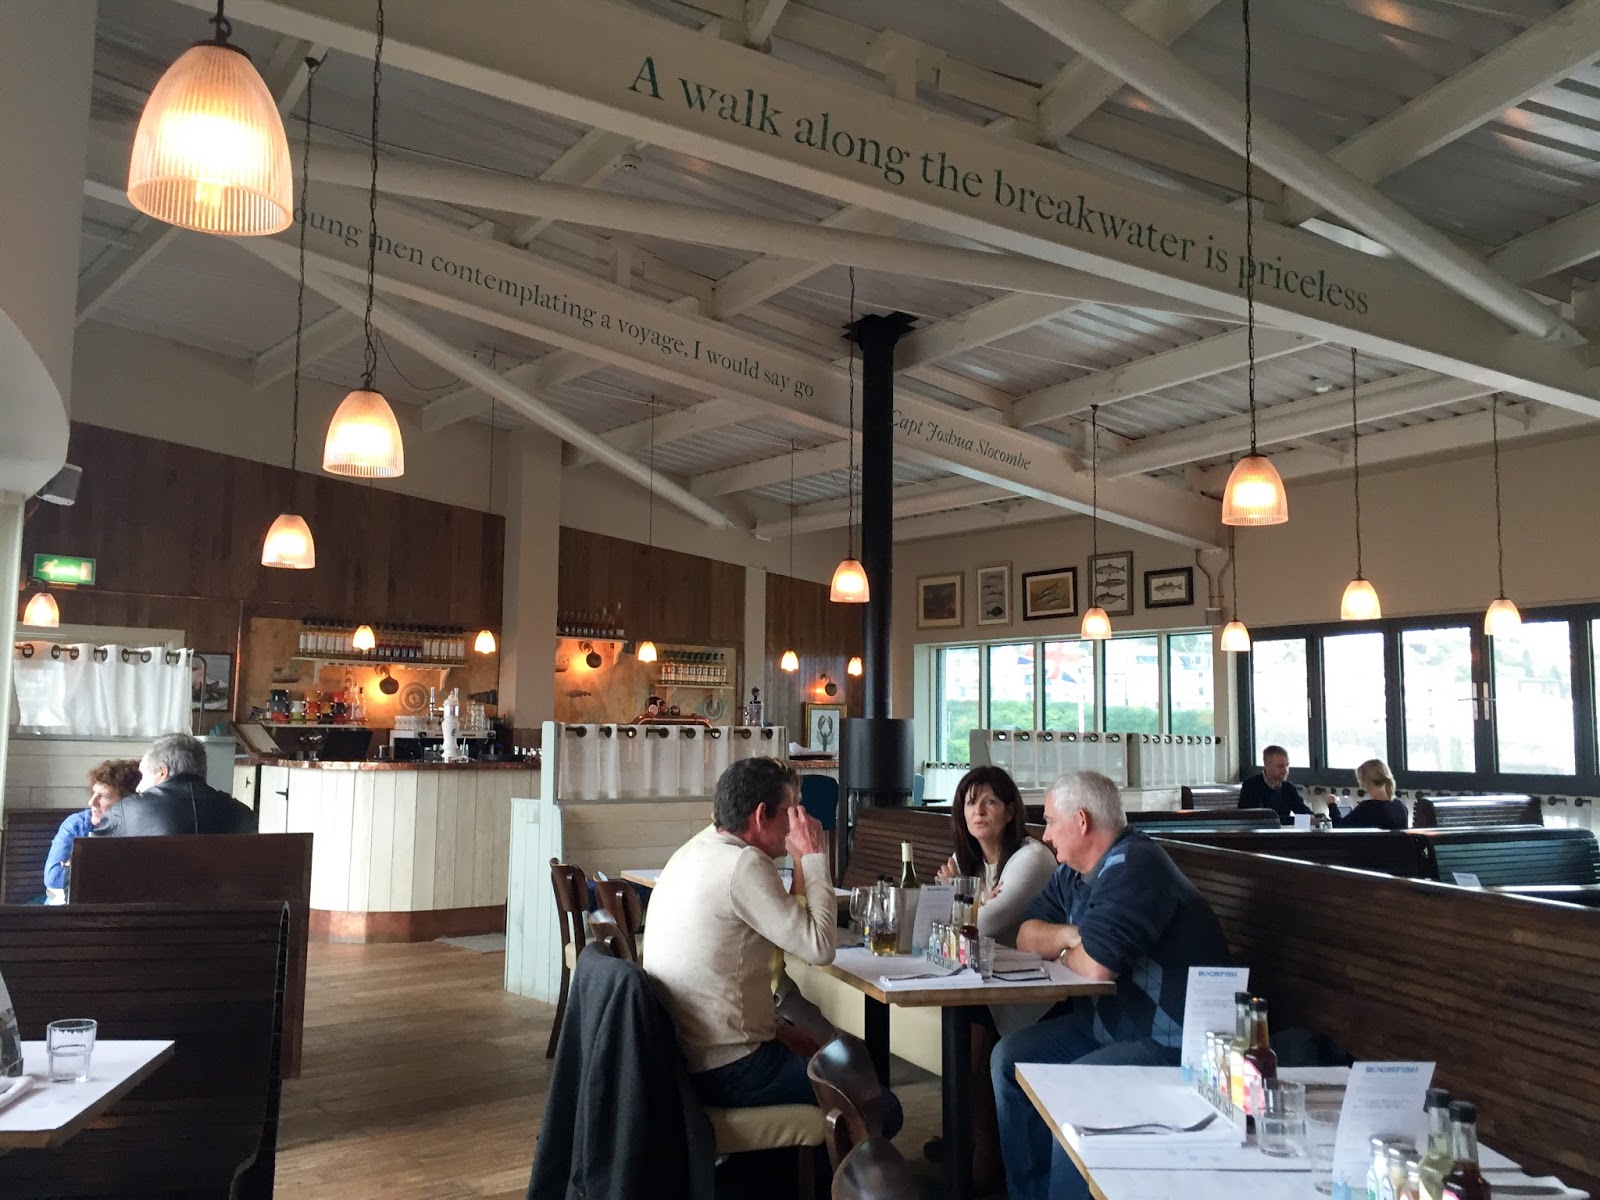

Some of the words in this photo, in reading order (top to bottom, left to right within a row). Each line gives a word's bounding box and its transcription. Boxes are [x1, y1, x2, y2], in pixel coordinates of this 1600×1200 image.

[627, 56, 665, 101] A
[677, 77, 783, 138] walk
[794, 113, 911, 186] along
[920, 151, 984, 198] the
[994, 169, 1196, 263] breakwater
[1202, 235, 1229, 273] is
[1237, 255, 1369, 315] priceless
[292, 207, 363, 249] oung
[369, 232, 424, 266] men
[431, 255, 597, 328] contemplating
[601, 312, 612, 329] a
[618, 319, 688, 358] voyage,
[693, 340, 702, 361] I
[707, 350, 760, 379] would
[764, 370, 790, 393] say
[794, 380, 815, 399] go
[926, 421, 974, 451] Joshua
[976, 439, 1032, 471] Slocombe
